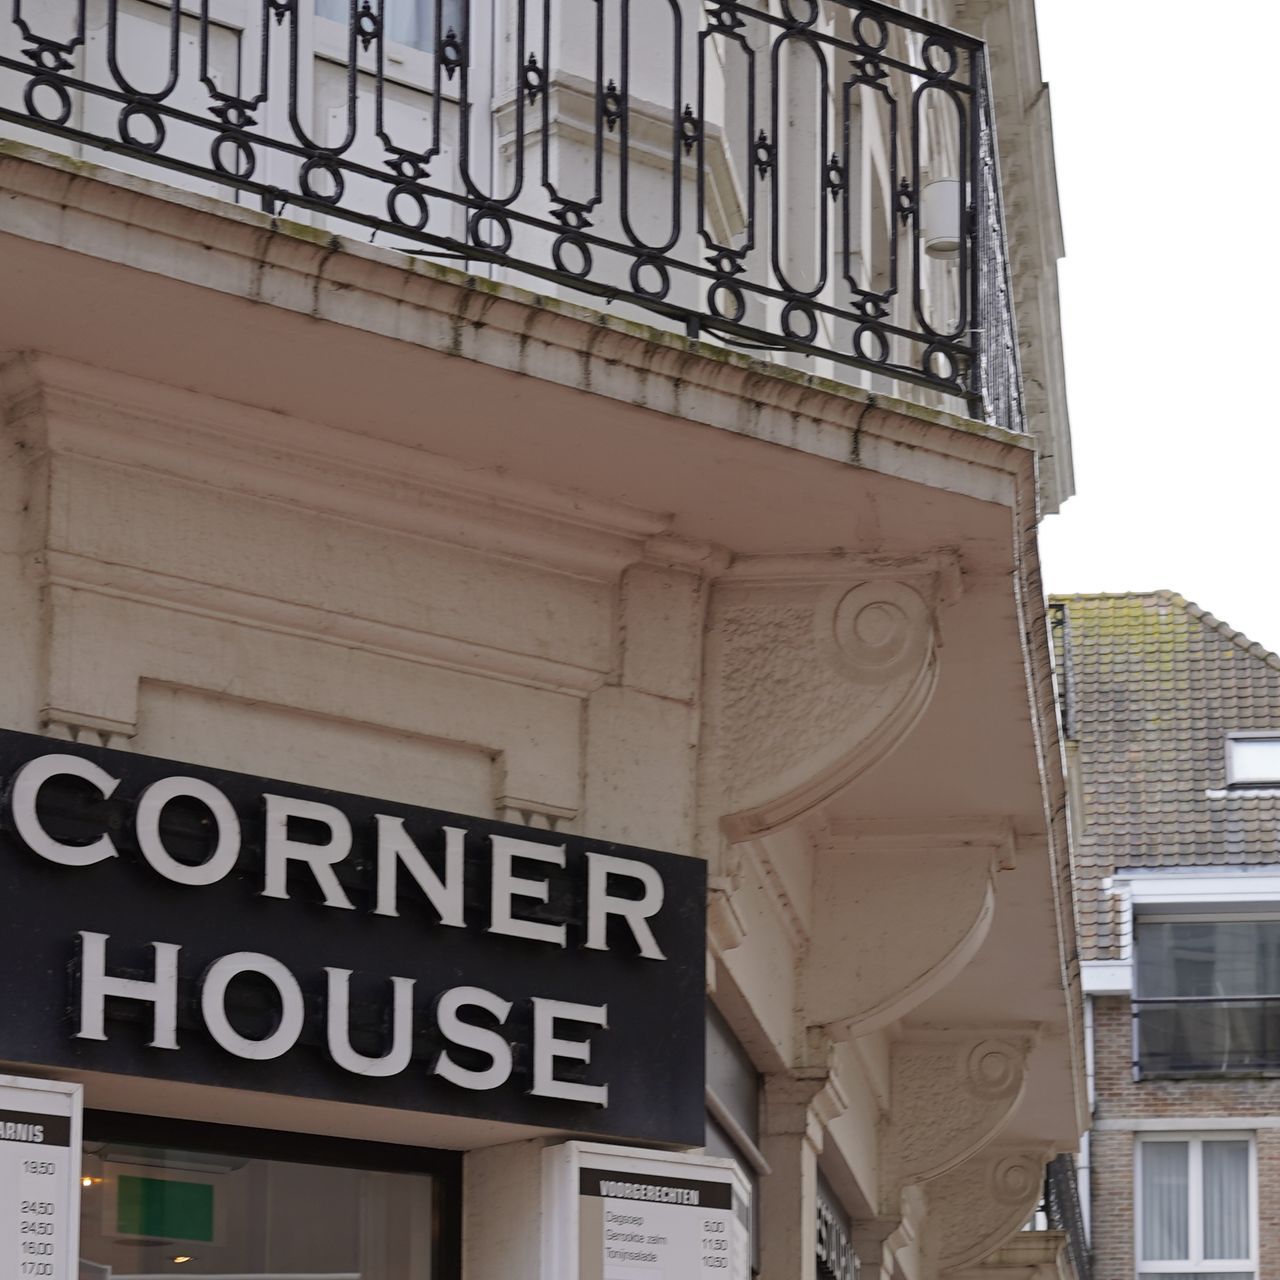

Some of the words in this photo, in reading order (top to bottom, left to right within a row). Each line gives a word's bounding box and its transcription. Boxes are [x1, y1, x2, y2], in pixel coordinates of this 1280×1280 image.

[11, 754, 667, 961] CORNER
[75, 930, 608, 1108] HOUSE
[599, 1180, 700, 1206] VOORGERECHTEN
